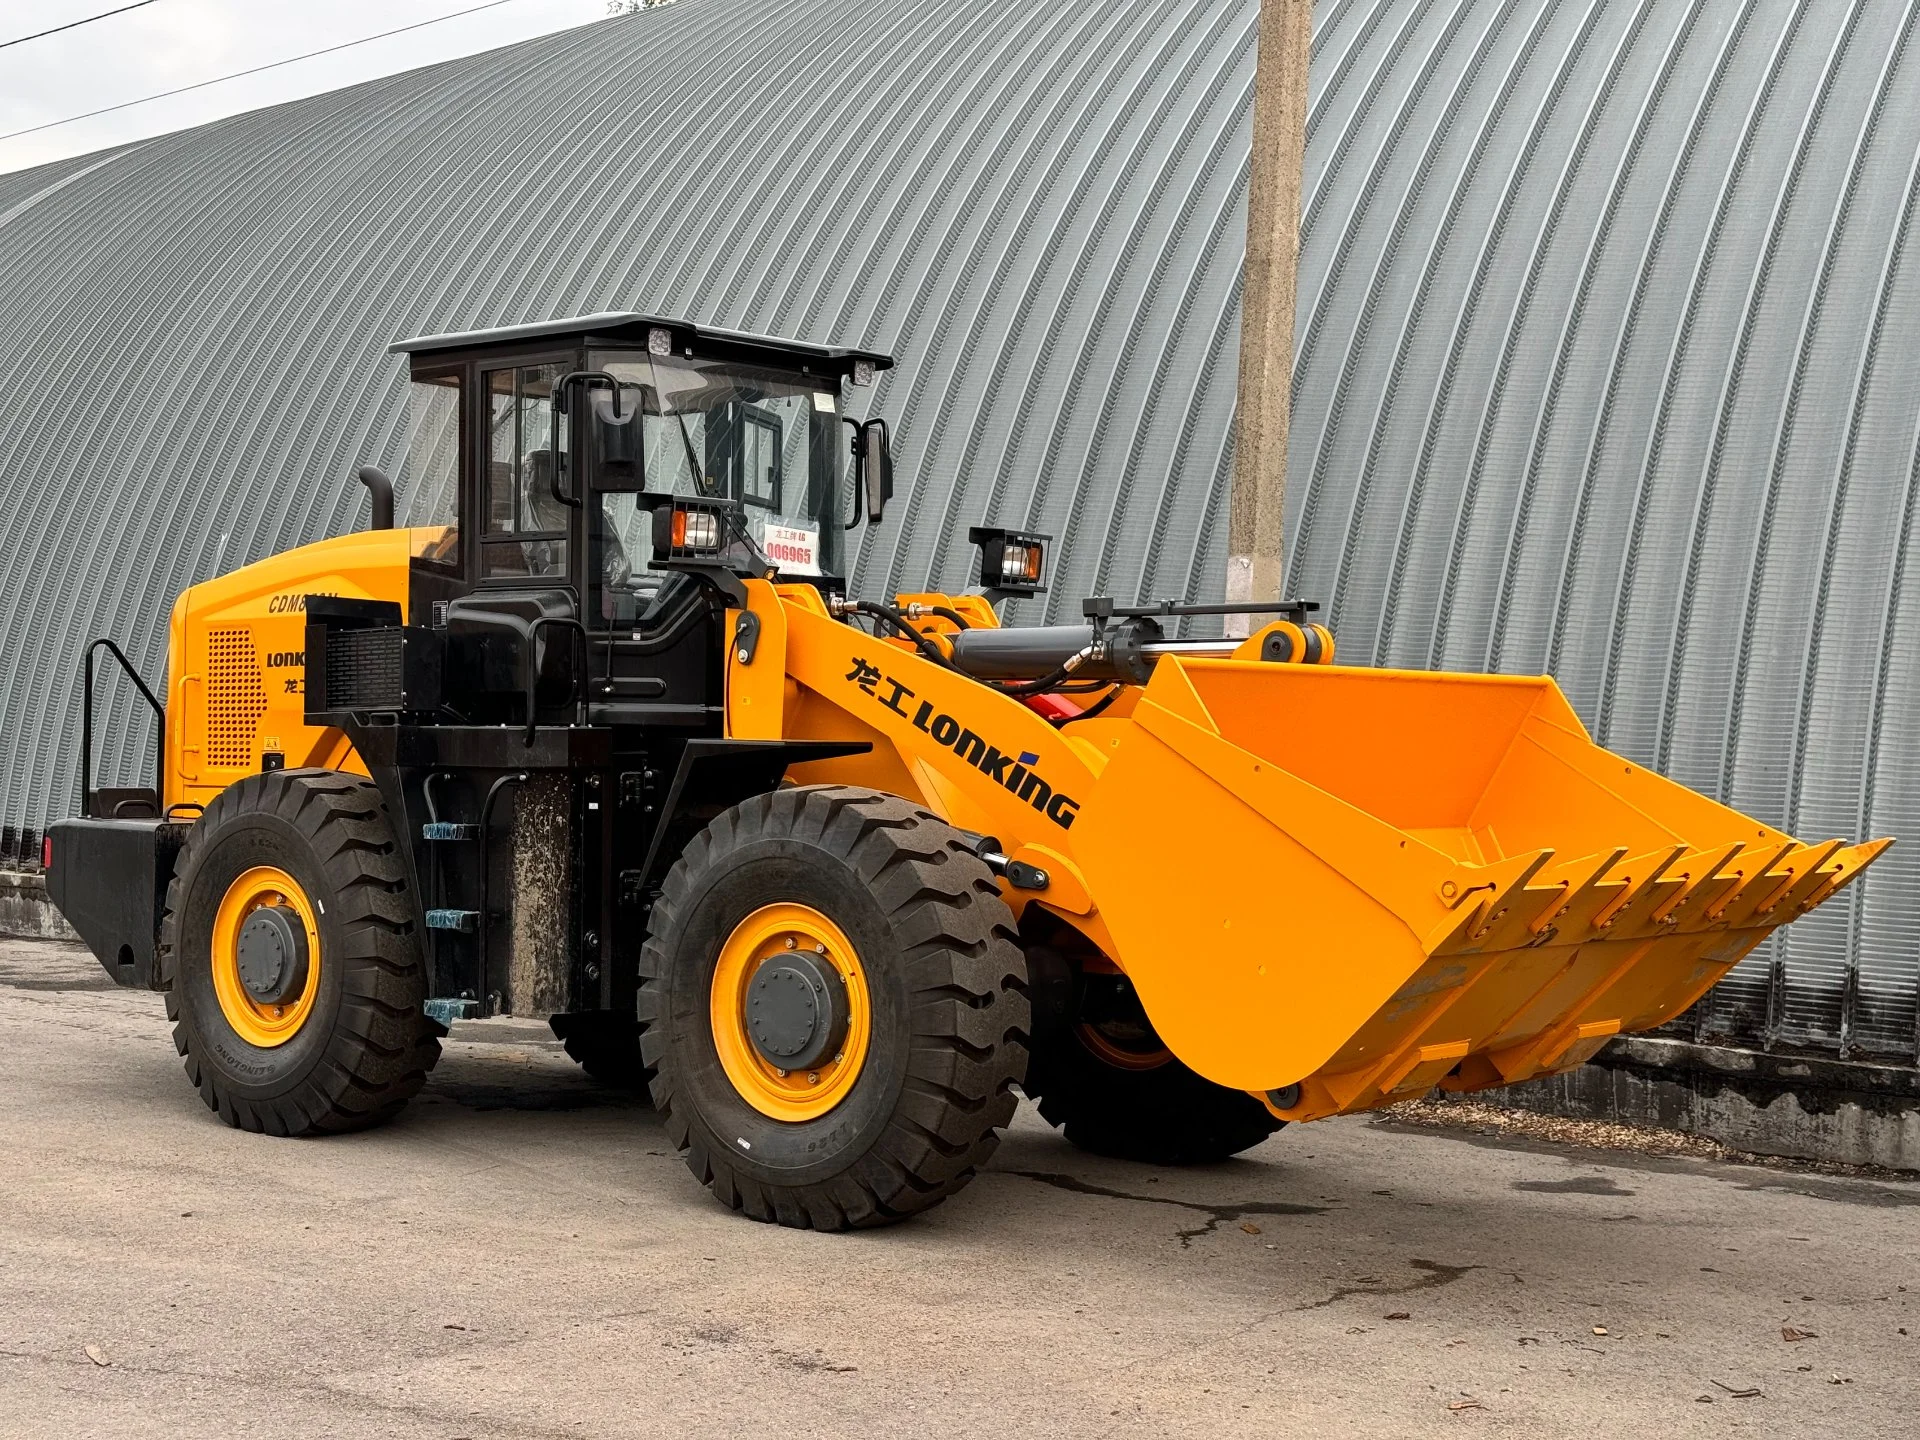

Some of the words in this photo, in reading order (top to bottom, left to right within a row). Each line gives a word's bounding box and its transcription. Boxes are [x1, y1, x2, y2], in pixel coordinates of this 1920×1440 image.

[767, 543, 811, 564] 006965
[267, 652, 305, 667] LONK
[845, 657, 915, 718] 龙工
[214, 1044, 266, 1076] LINGLONG
